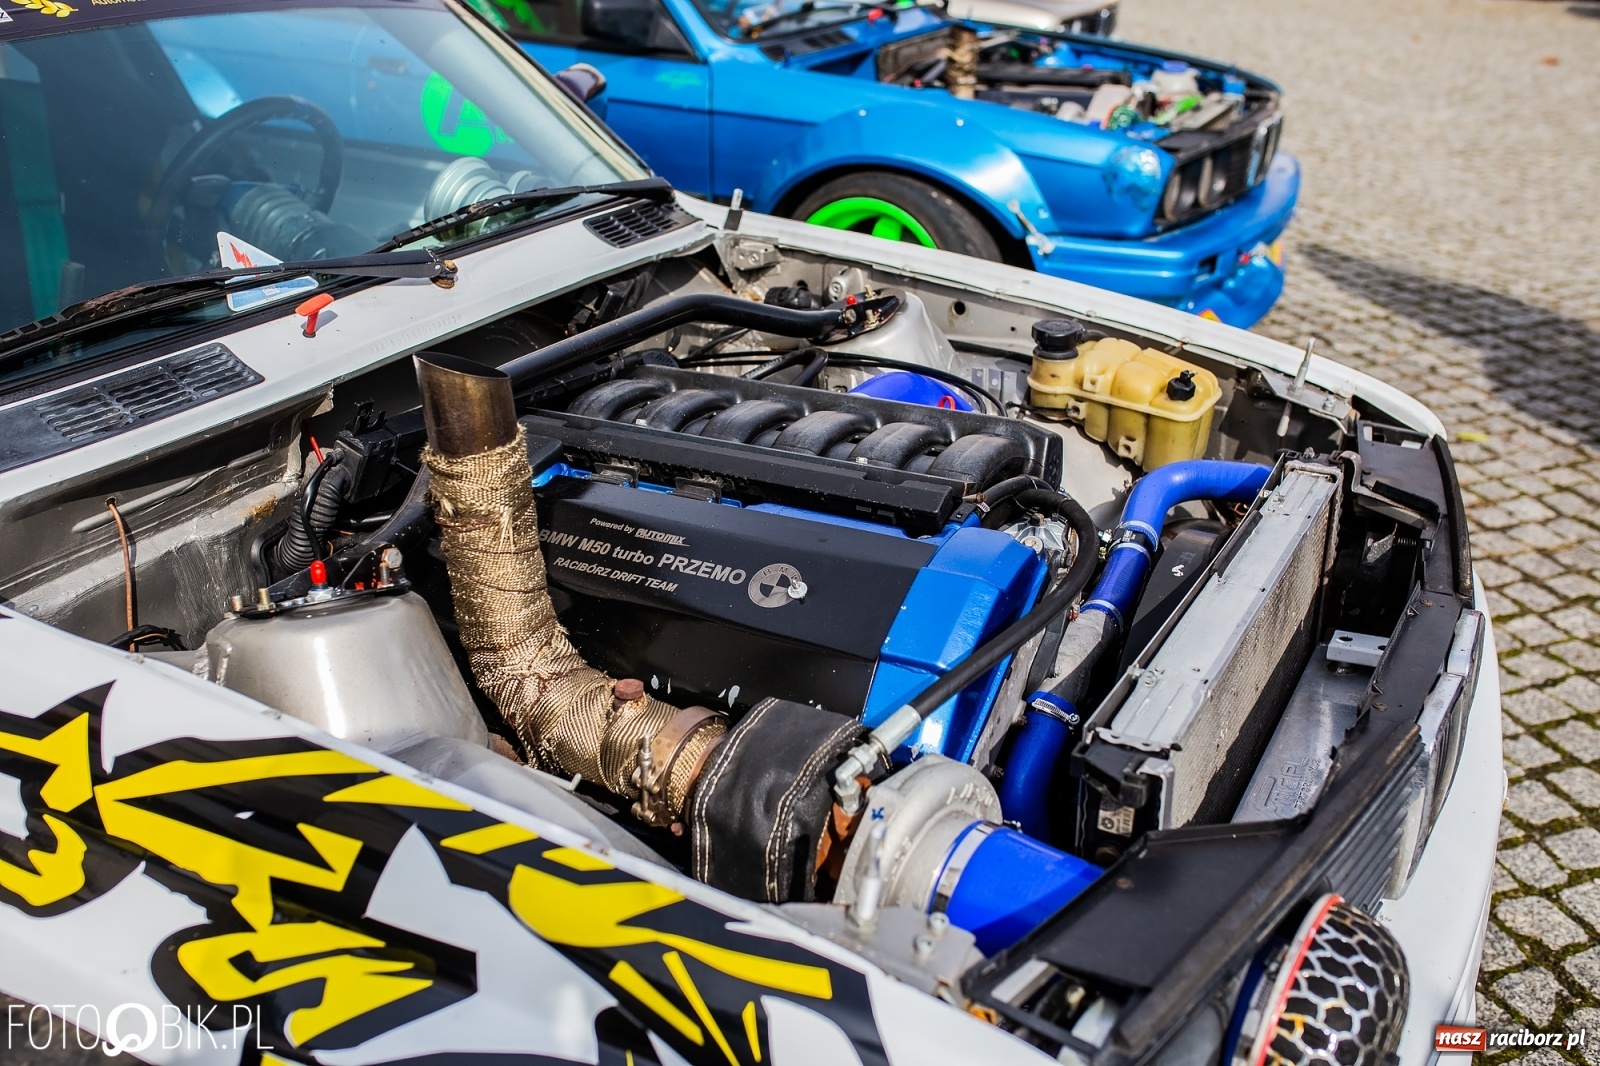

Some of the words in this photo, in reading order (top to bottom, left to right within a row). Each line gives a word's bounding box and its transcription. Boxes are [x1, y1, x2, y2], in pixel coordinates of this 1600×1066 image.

[589, 517, 624, 531] Powered
[624, 525, 636, 534] by
[634, 528, 690, 546] AUTOMIX
[538, 529, 580, 548] BMW
[578, 537, 612, 556] M50
[612, 546, 655, 565] turbo
[657, 553, 747, 585] PRZEMO
[553, 557, 611, 577] RACIBÓRZ
[610, 569, 646, 585] DRIFT
[645, 577, 679, 593] TEAM
